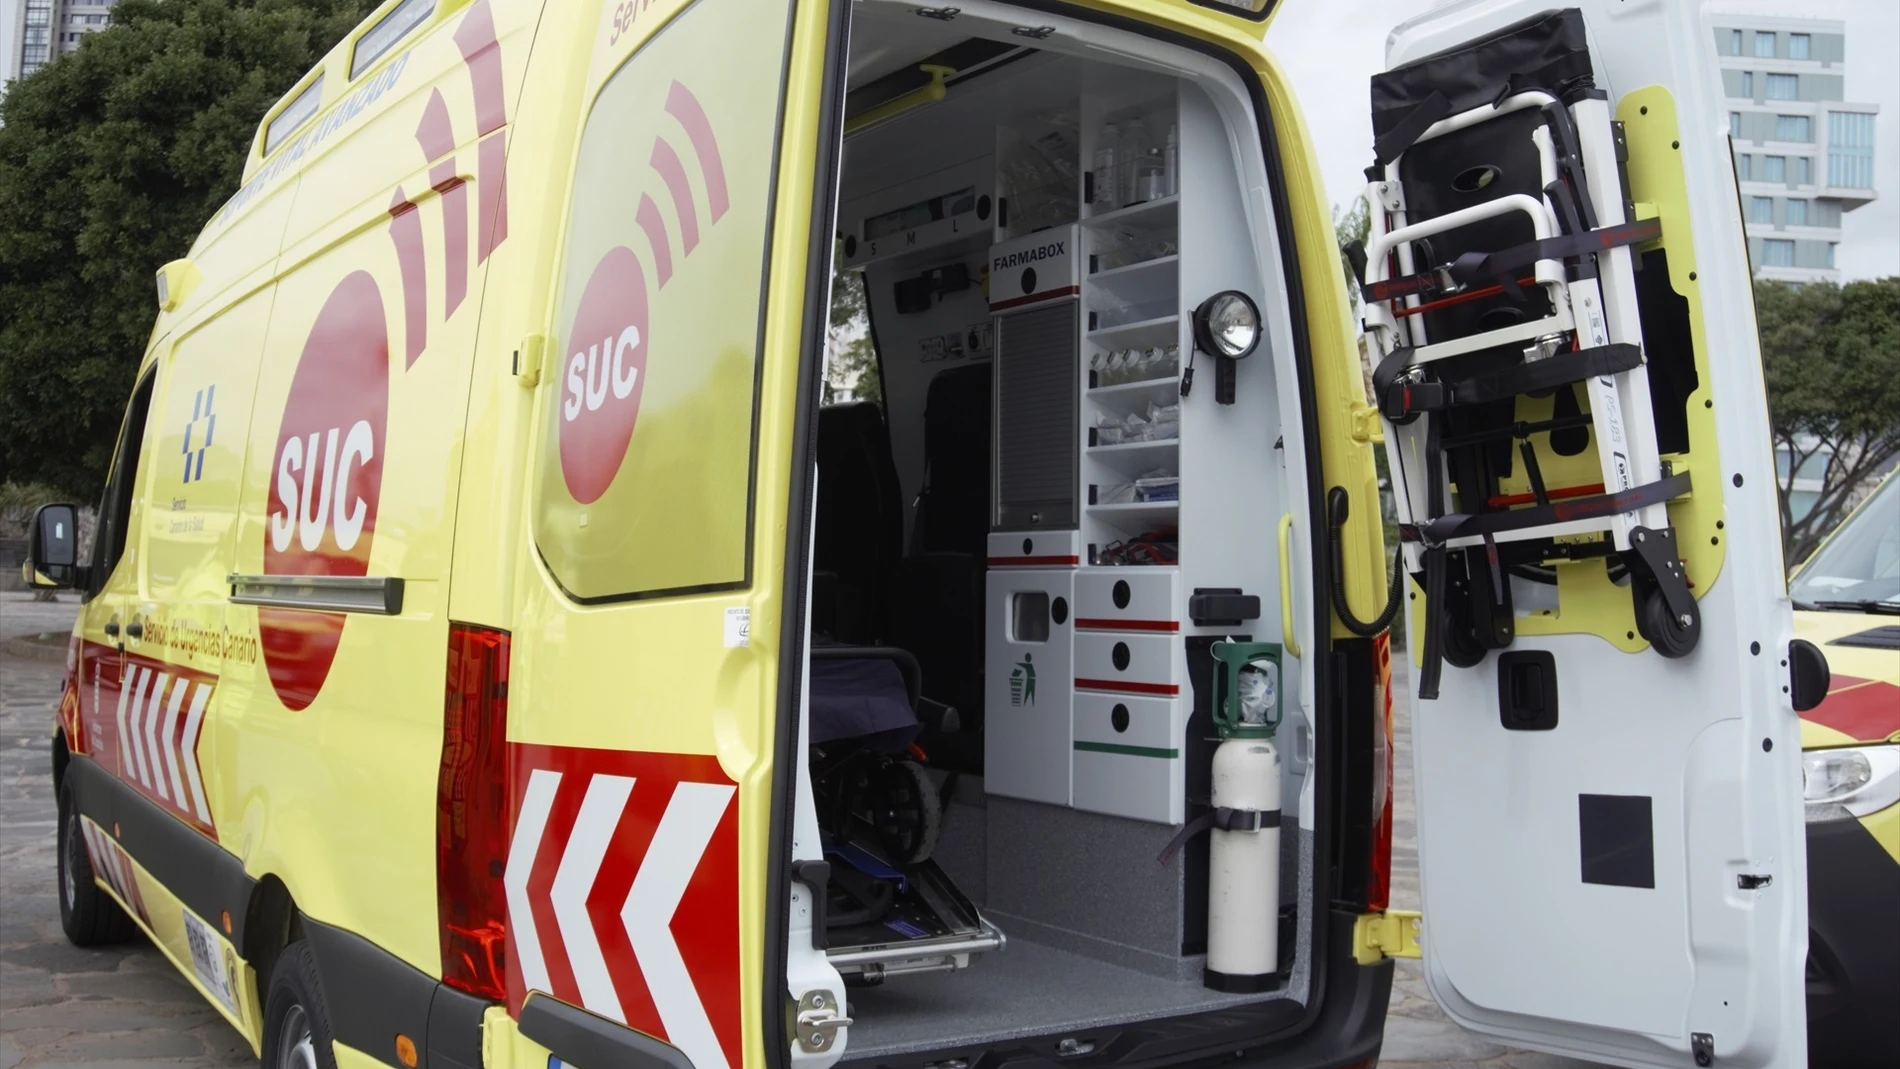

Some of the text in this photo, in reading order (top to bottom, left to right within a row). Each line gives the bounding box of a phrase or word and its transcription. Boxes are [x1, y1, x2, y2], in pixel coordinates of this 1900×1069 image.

[309, 50, 411, 149] AVANZADO
[871, 219, 959, 256] S M L
[993, 241, 1065, 271] FARMABOX
[564, 324, 640, 422] SUC
[271, 419, 374, 553] SUC
[144, 614, 257, 665] Servicio de Urgencias Canario
